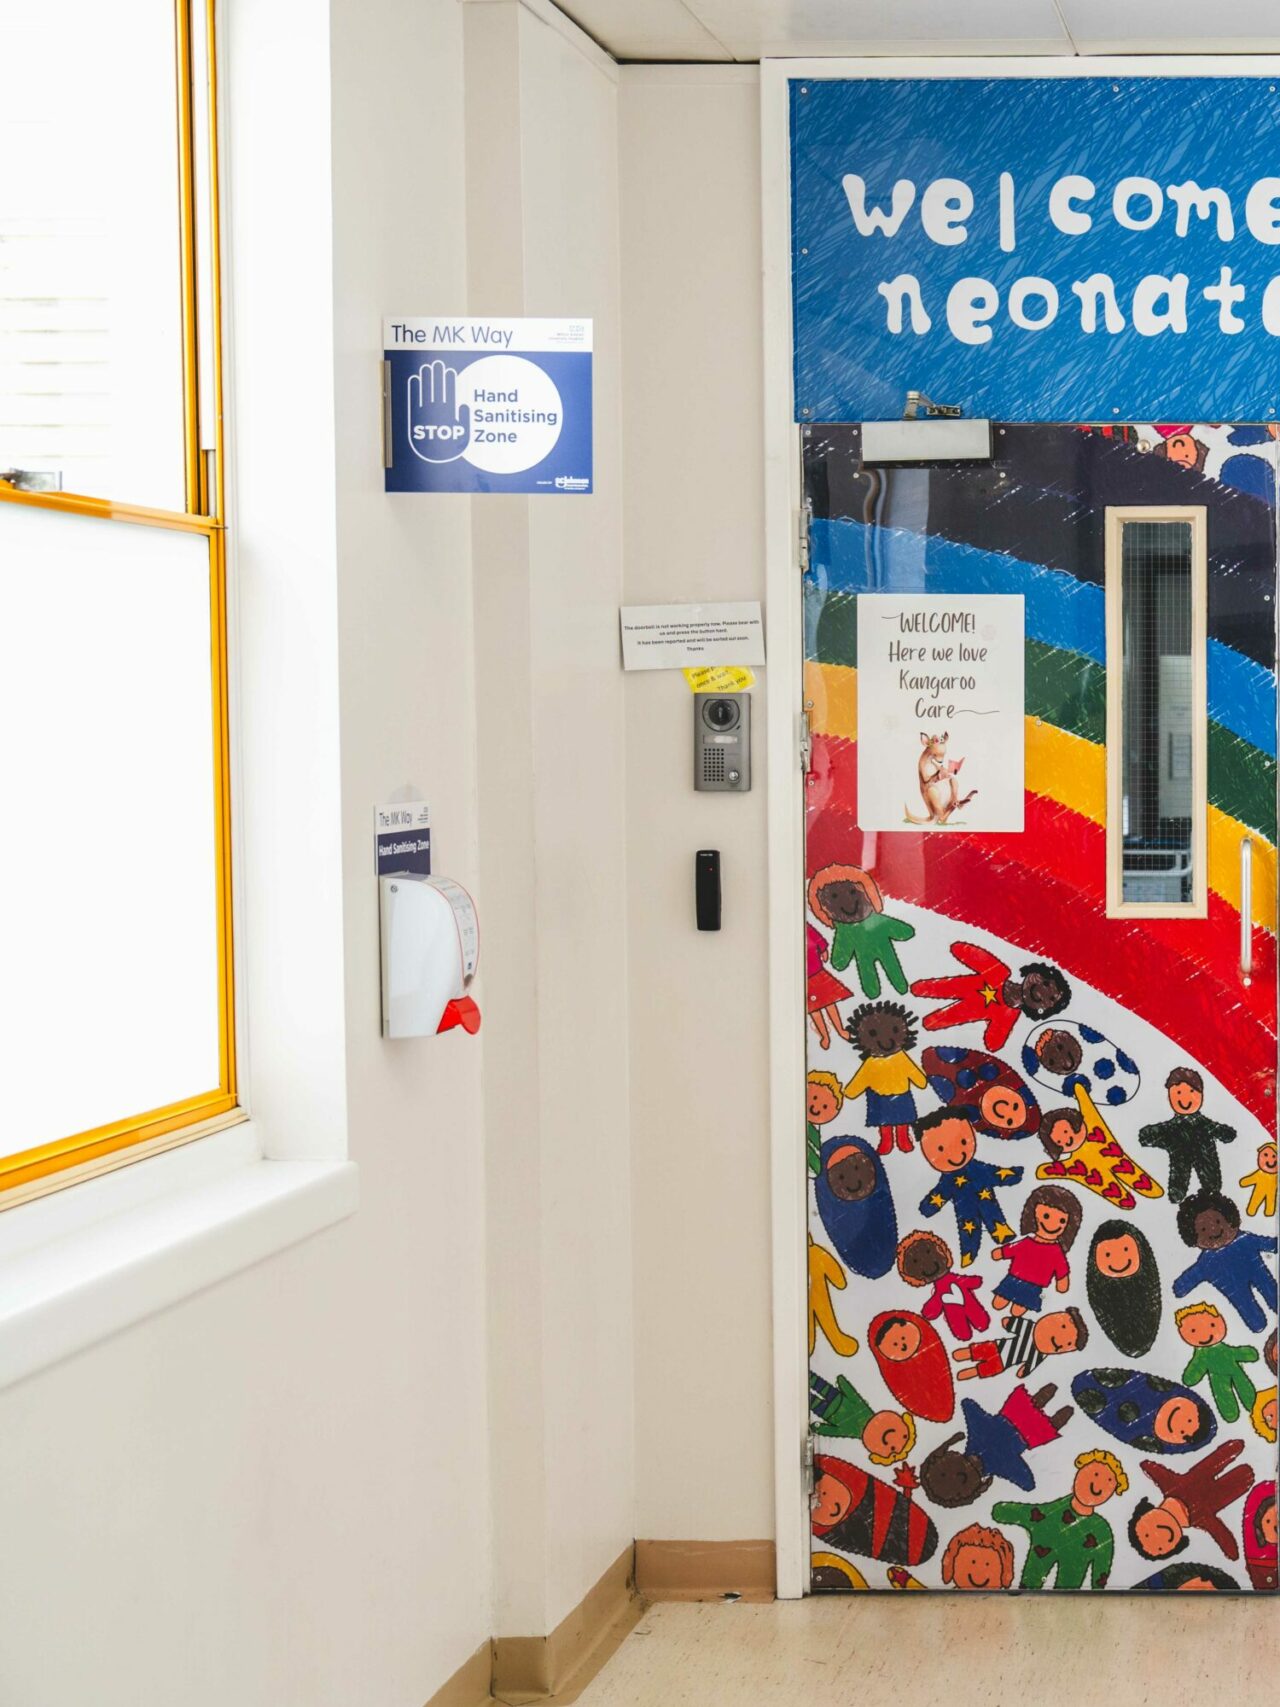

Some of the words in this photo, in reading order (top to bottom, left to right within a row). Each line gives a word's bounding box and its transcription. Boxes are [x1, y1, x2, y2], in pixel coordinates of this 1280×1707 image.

[391, 325, 426, 343] The
[432, 326, 465, 343] MK
[472, 326, 513, 348] Way
[474, 389, 518, 402] Hand
[474, 409, 557, 426] Sanitising
[413, 425, 465, 440] STOP
[474, 429, 517, 443] Zone
[900, 612, 975, 633] WELCOME!
[888, 641, 926, 662] Here
[932, 647, 952, 662] we
[959, 642, 988, 662] love
[899, 669, 976, 698] Kangaroo
[915, 698, 955, 719] Care
[379, 812, 389, 827] The
[391, 811, 400, 825] MK
[401, 810, 413, 827] Way
[379, 843, 392, 857] Hand
[393, 841, 417, 854] Sanitising
[417, 840, 430, 851] Zone
